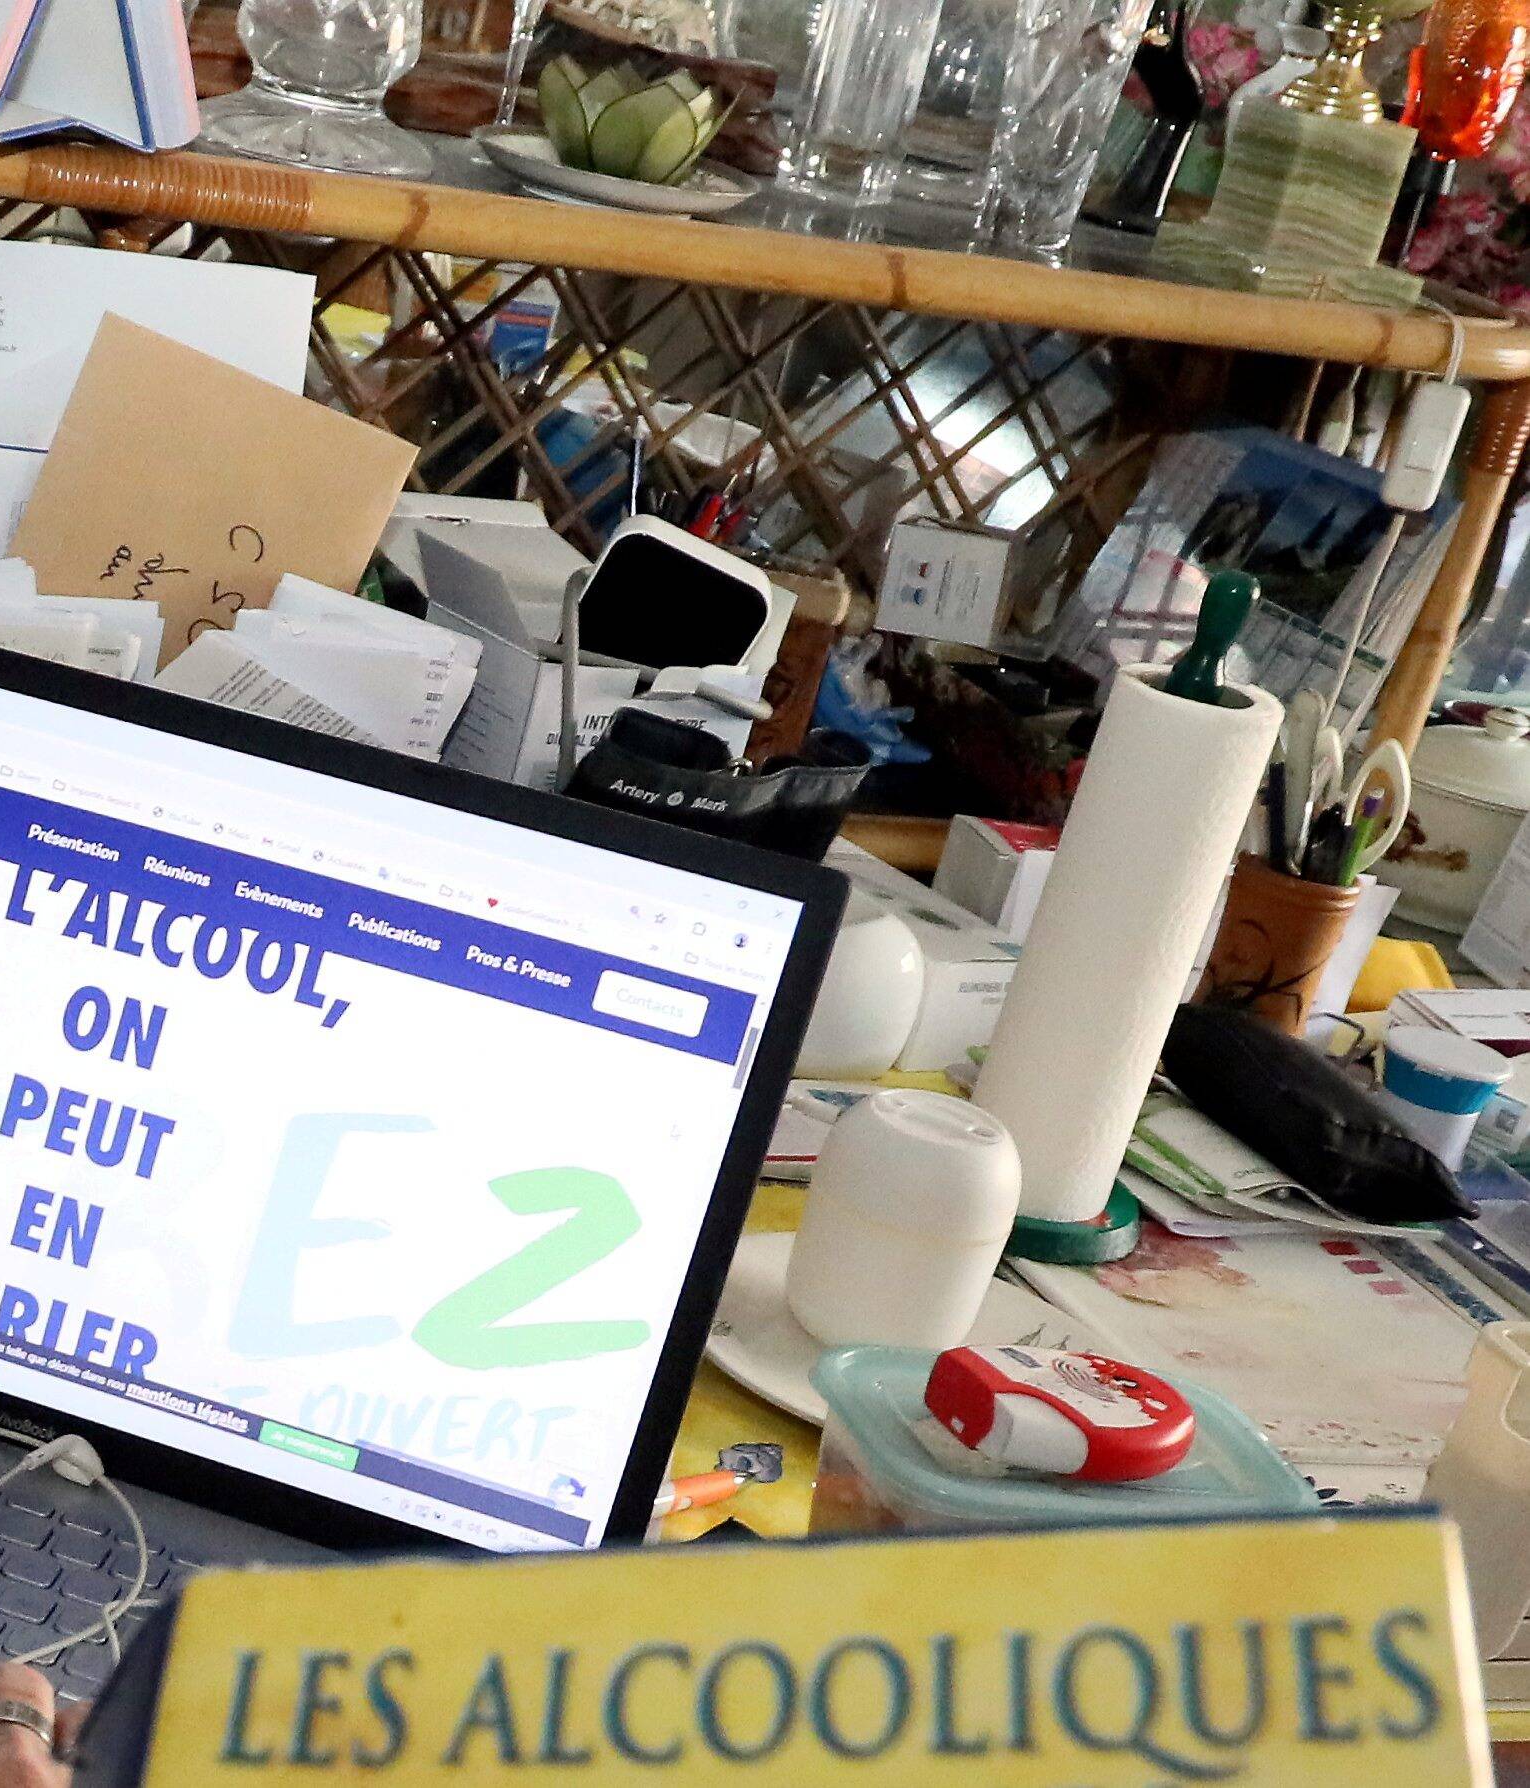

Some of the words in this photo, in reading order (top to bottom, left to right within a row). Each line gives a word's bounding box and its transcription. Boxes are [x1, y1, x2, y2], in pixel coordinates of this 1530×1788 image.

[608, 778, 662, 804] Artery
[689, 796, 730, 813] Mark
[27, 823, 120, 863] Présentation
[142, 854, 212, 888] Réunions
[347, 911, 443, 952] Publications
[465, 944, 502, 970] Pros
[502, 955, 519, 974] &
[519, 958, 572, 989] Presse
[615, 986, 685, 1020] Contacts
[61, 984, 168, 1071] ON
[10, 1184, 105, 1269] EN
[125, 1382, 196, 1415] mentions
[196, 1401, 249, 1433] légales
[217, 1643, 417, 1769] LES
[440, 1608, 1447, 1783] ALCOOLIQUES
